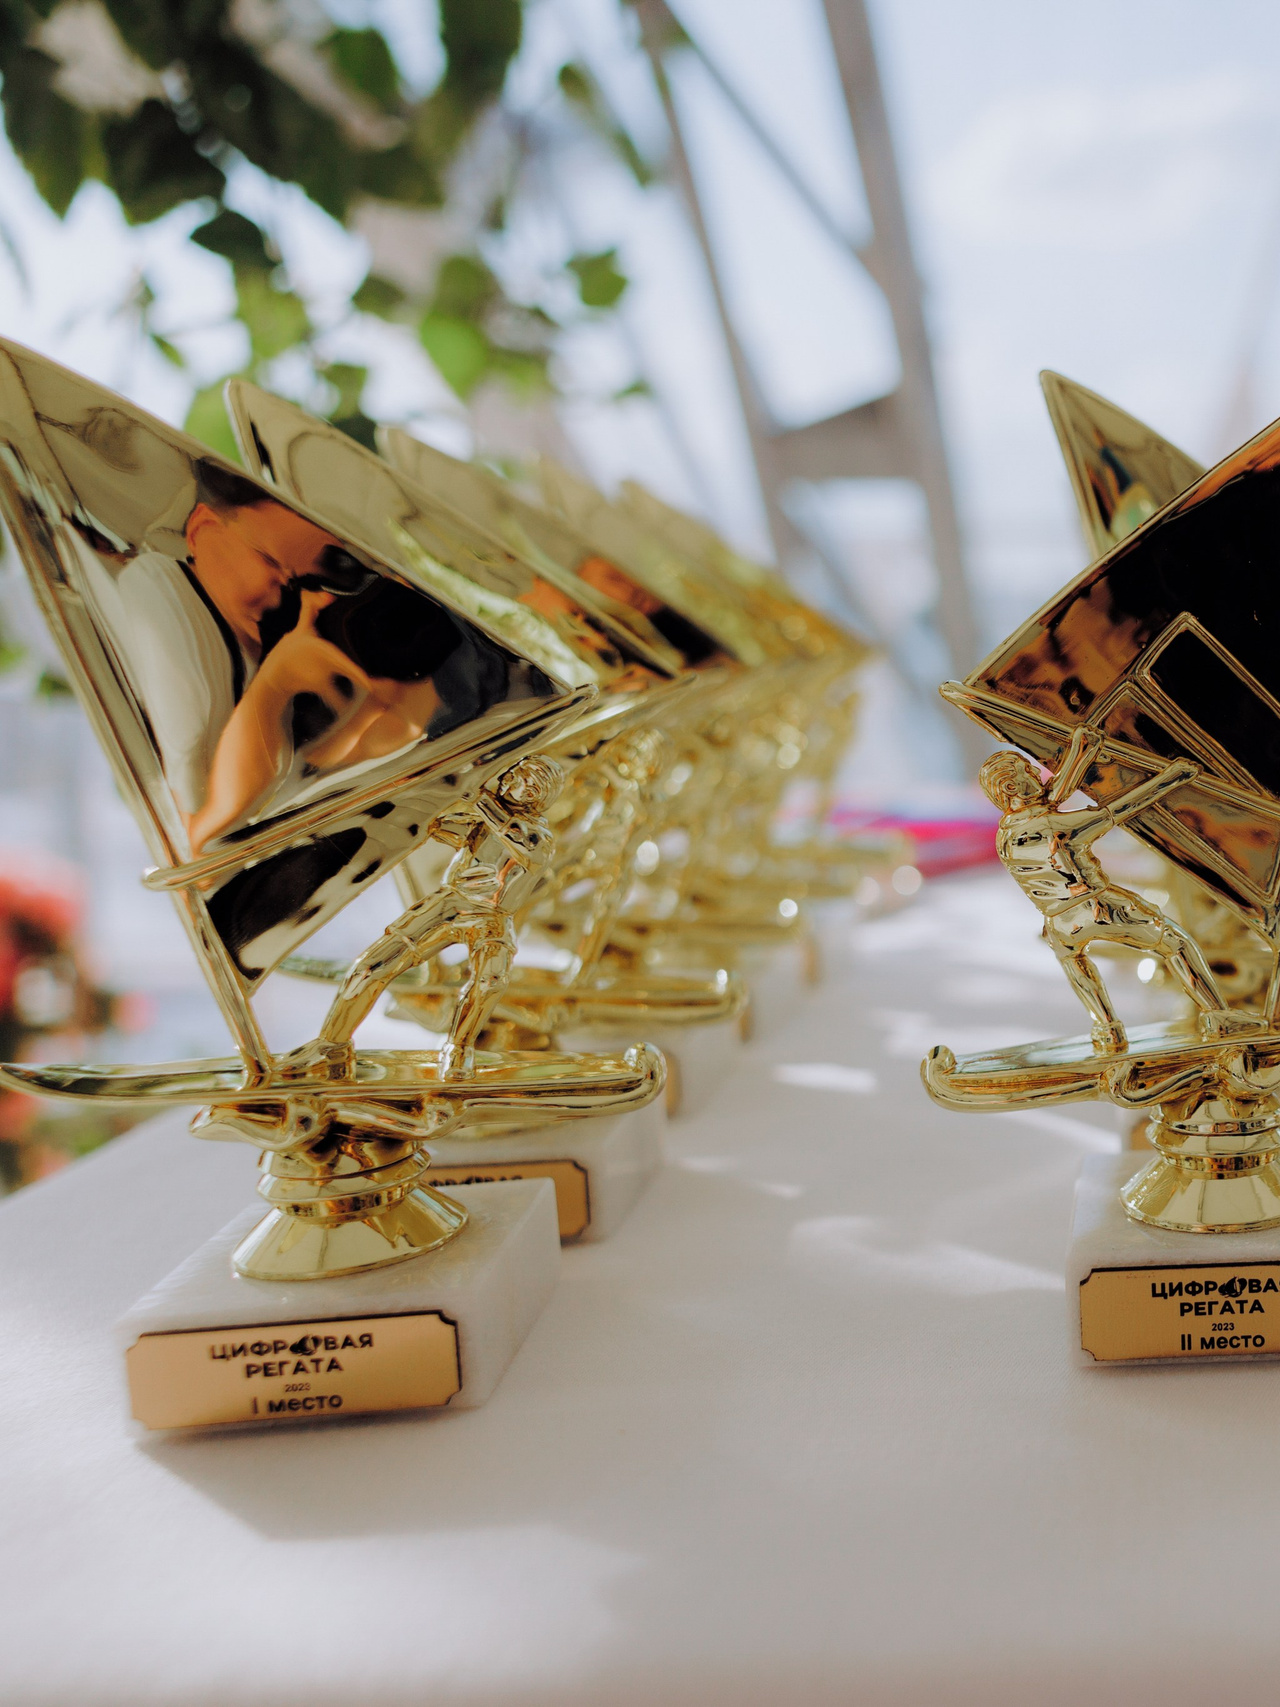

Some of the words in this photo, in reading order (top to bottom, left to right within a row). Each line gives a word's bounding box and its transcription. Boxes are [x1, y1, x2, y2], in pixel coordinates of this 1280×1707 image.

[1179, 1299, 1265, 1317] РЕГАТА
[1211, 1322, 1235, 1331] 2023
[1180, 1334, 1192, 1350] II
[1200, 1334, 1266, 1350] место
[245, 1357, 344, 1378] РЕГАТА
[285, 1382, 312, 1393] 2023
[267, 1394, 344, 1414] место
